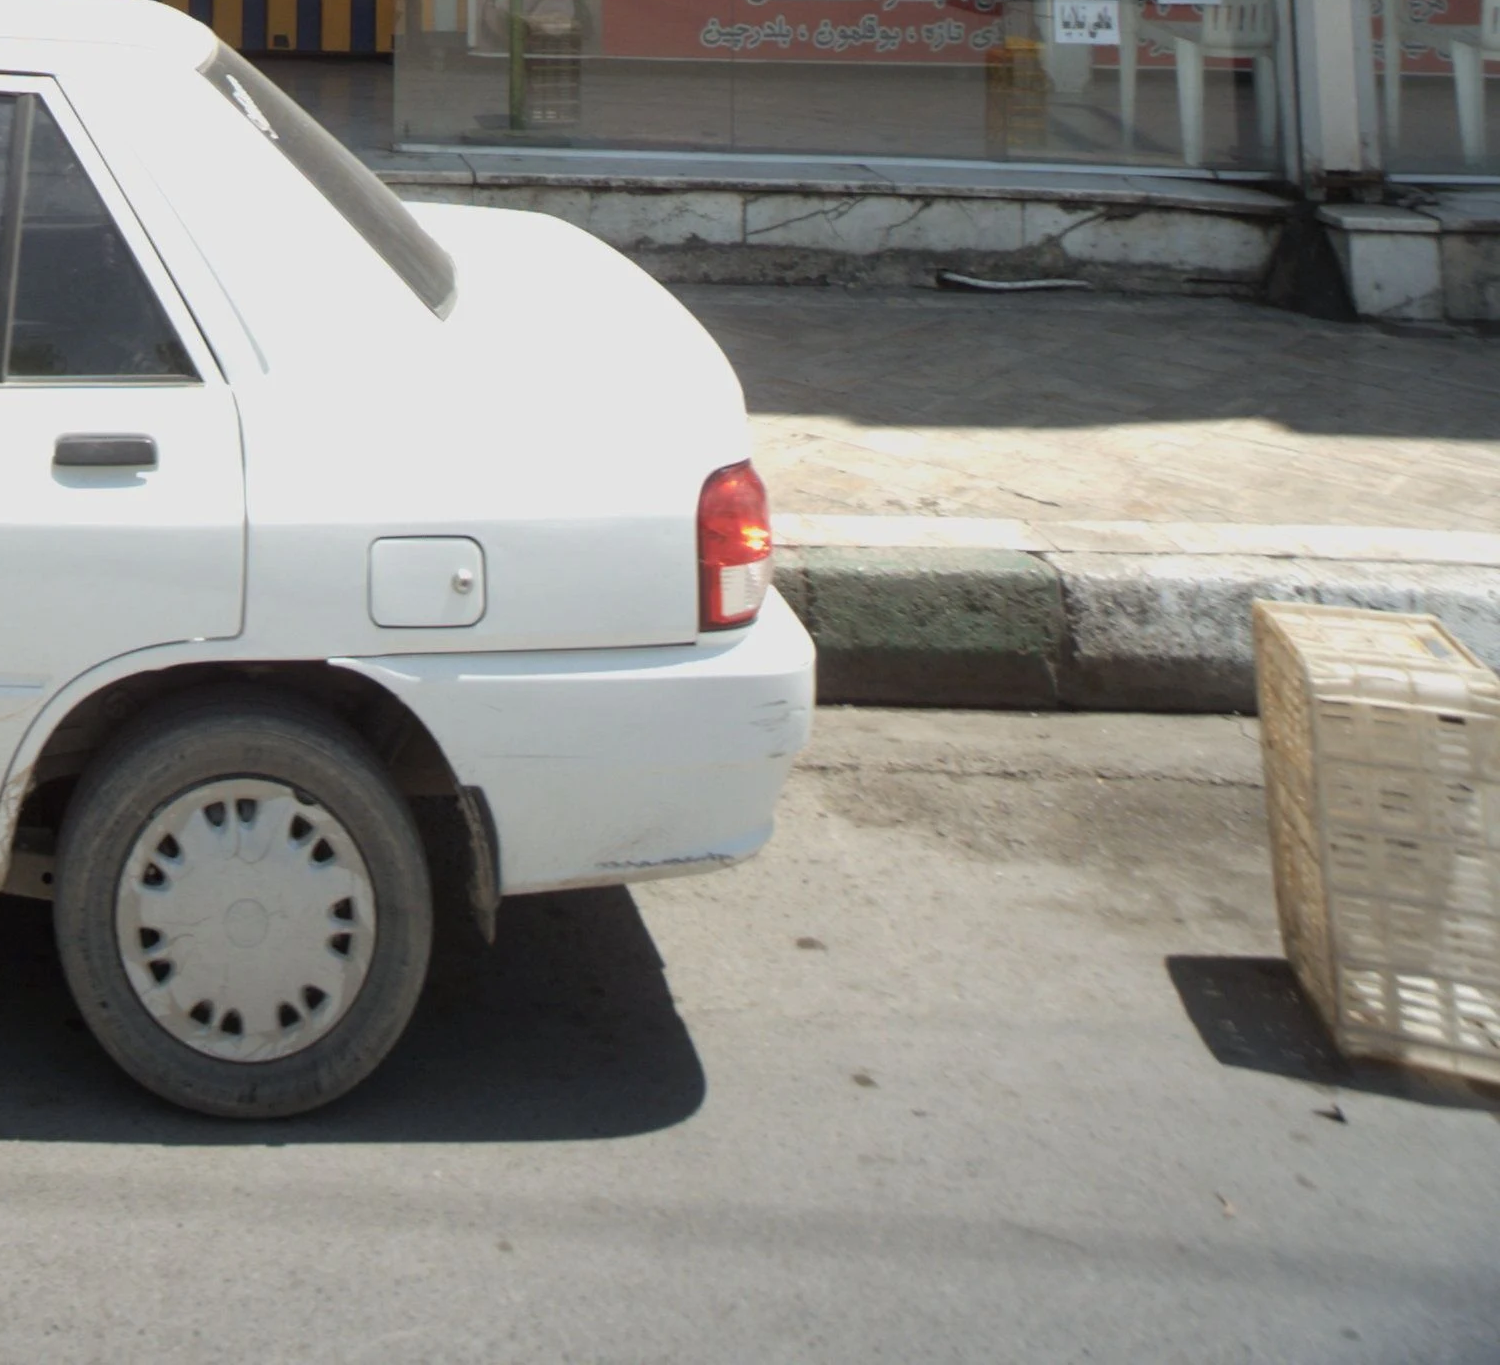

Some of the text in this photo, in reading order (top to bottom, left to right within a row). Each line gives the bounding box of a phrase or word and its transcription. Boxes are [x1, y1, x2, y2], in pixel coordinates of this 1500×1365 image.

[700, 16, 793, 51] بلدرچین
[813, 14, 902, 53] بوقلمون
[920, 20, 965, 53] تازه
